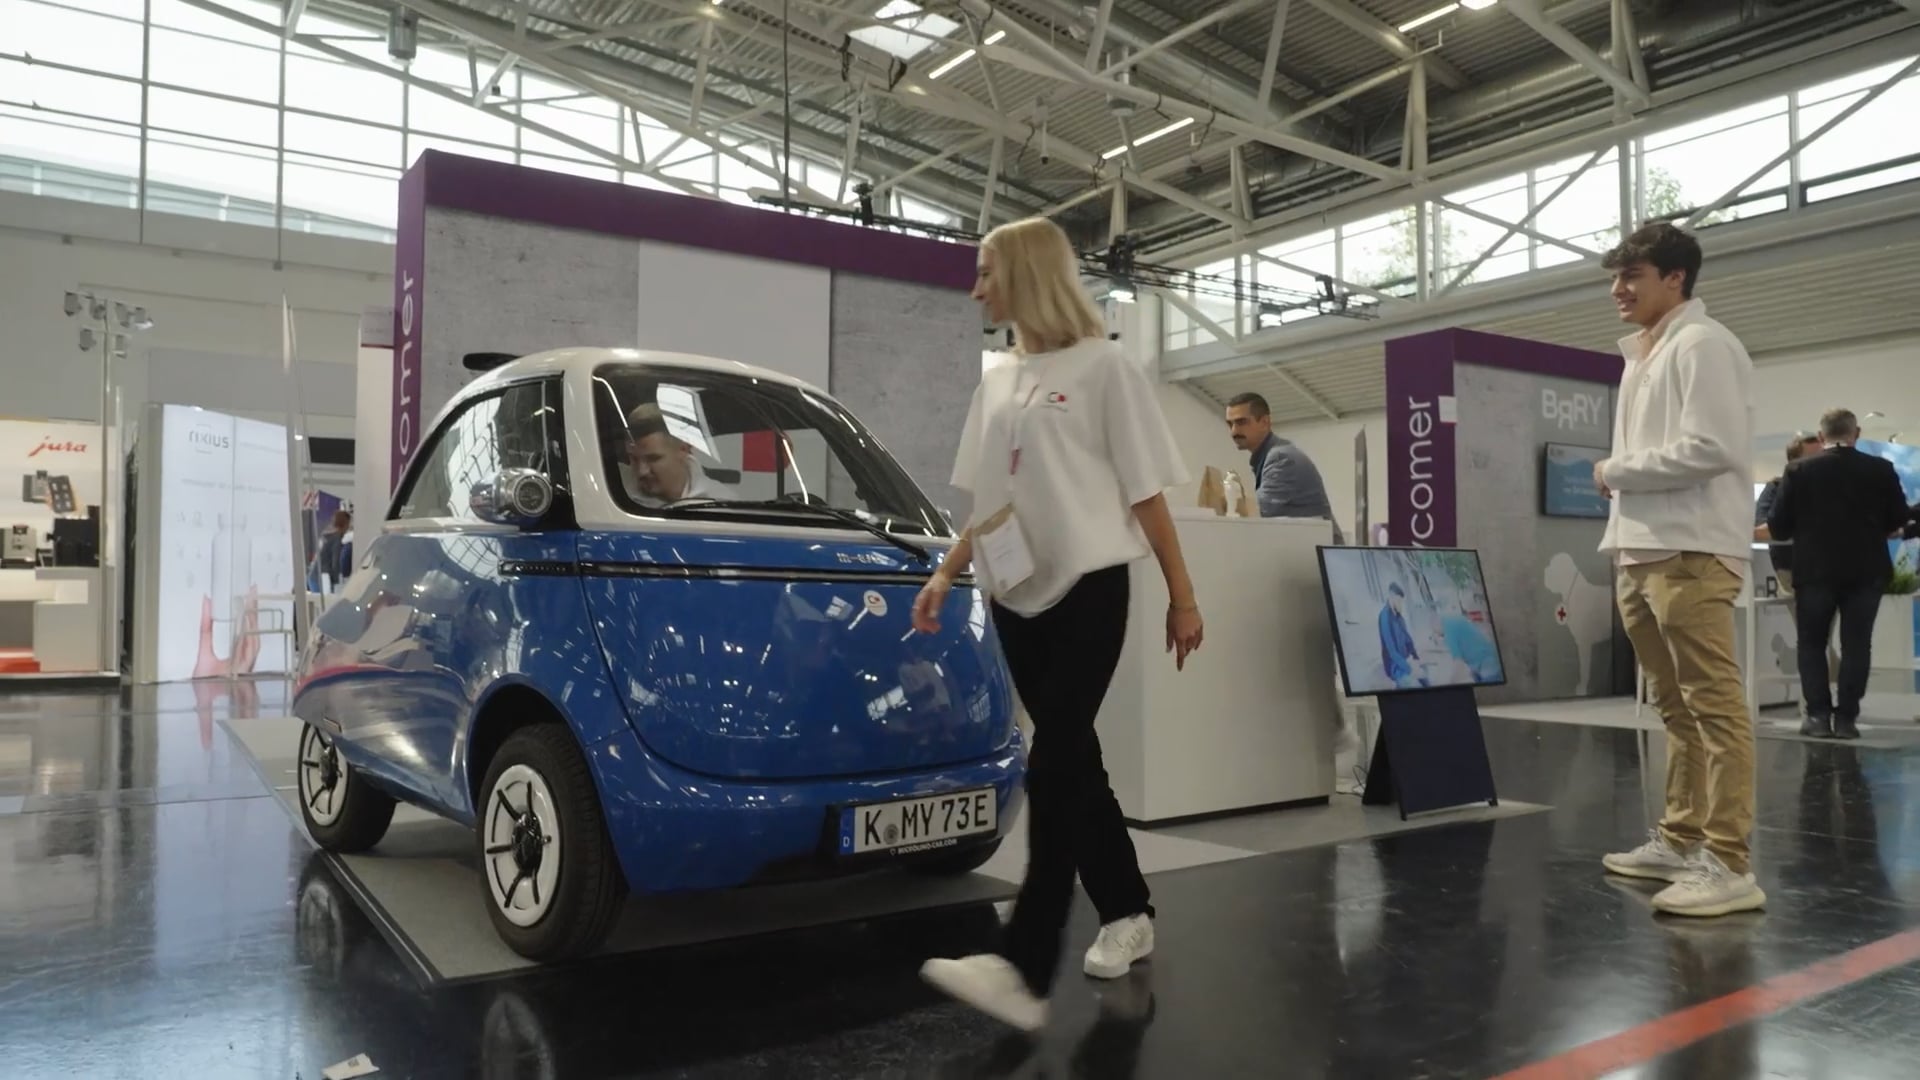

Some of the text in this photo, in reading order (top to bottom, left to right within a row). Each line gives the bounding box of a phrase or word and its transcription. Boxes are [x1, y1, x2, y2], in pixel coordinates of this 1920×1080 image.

[28, 435, 87, 457] jura
[864, 794, 989, 846] K MY 73E
[843, 836, 850, 847] D
